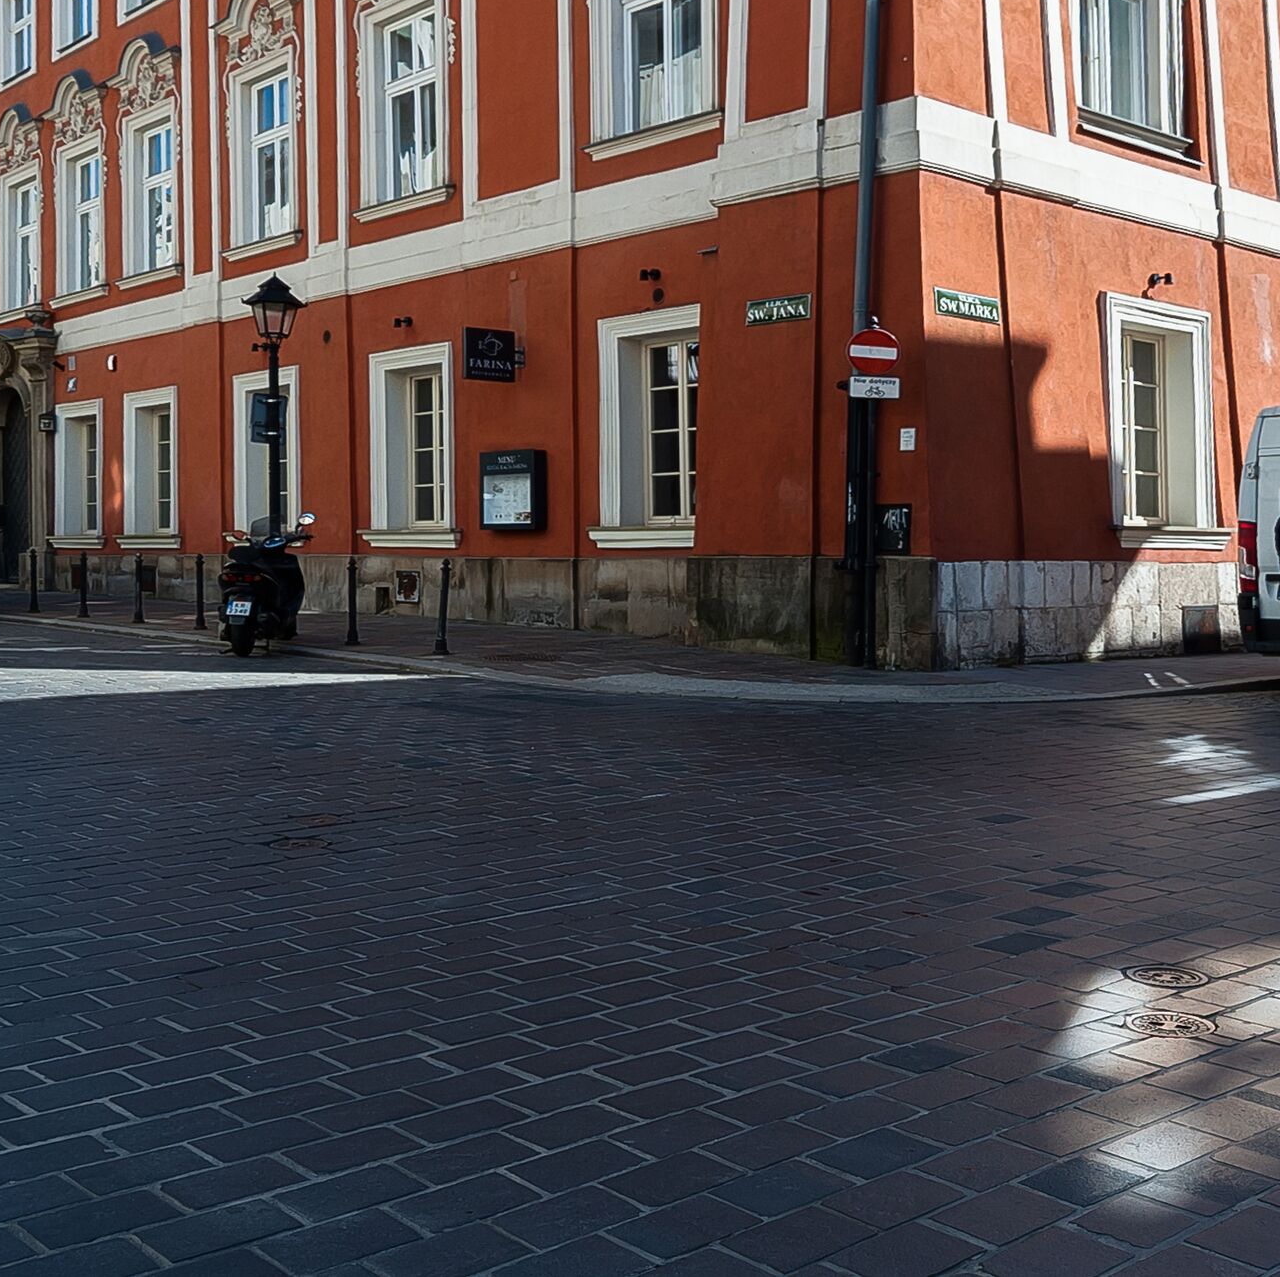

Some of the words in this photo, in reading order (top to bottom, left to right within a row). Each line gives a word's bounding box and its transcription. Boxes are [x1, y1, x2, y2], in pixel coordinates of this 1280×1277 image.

[772, 304, 806, 320] JANA
[959, 302, 999, 321] MARKA
[470, 358, 512, 371] FARINA
[869, 378, 897, 386] dotyczy
